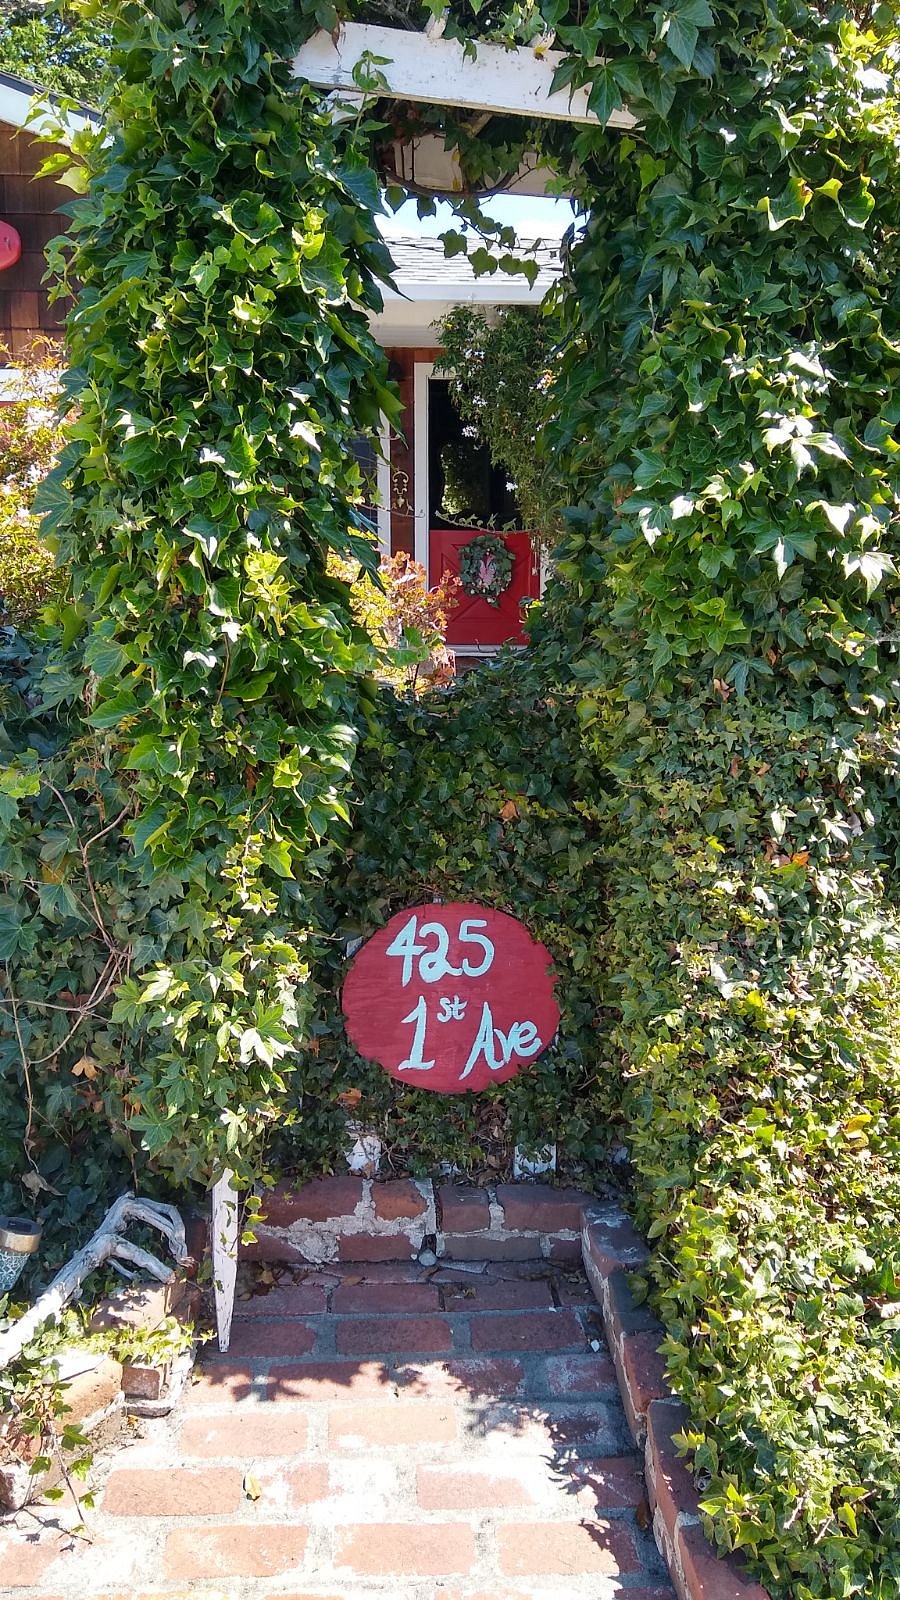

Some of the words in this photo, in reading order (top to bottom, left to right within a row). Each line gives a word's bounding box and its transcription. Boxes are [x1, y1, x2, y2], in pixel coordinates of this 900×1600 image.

[386, 914, 495, 987] 425
[398, 995, 467, 1071] 1st
[458, 1001, 543, 1081] Ave
